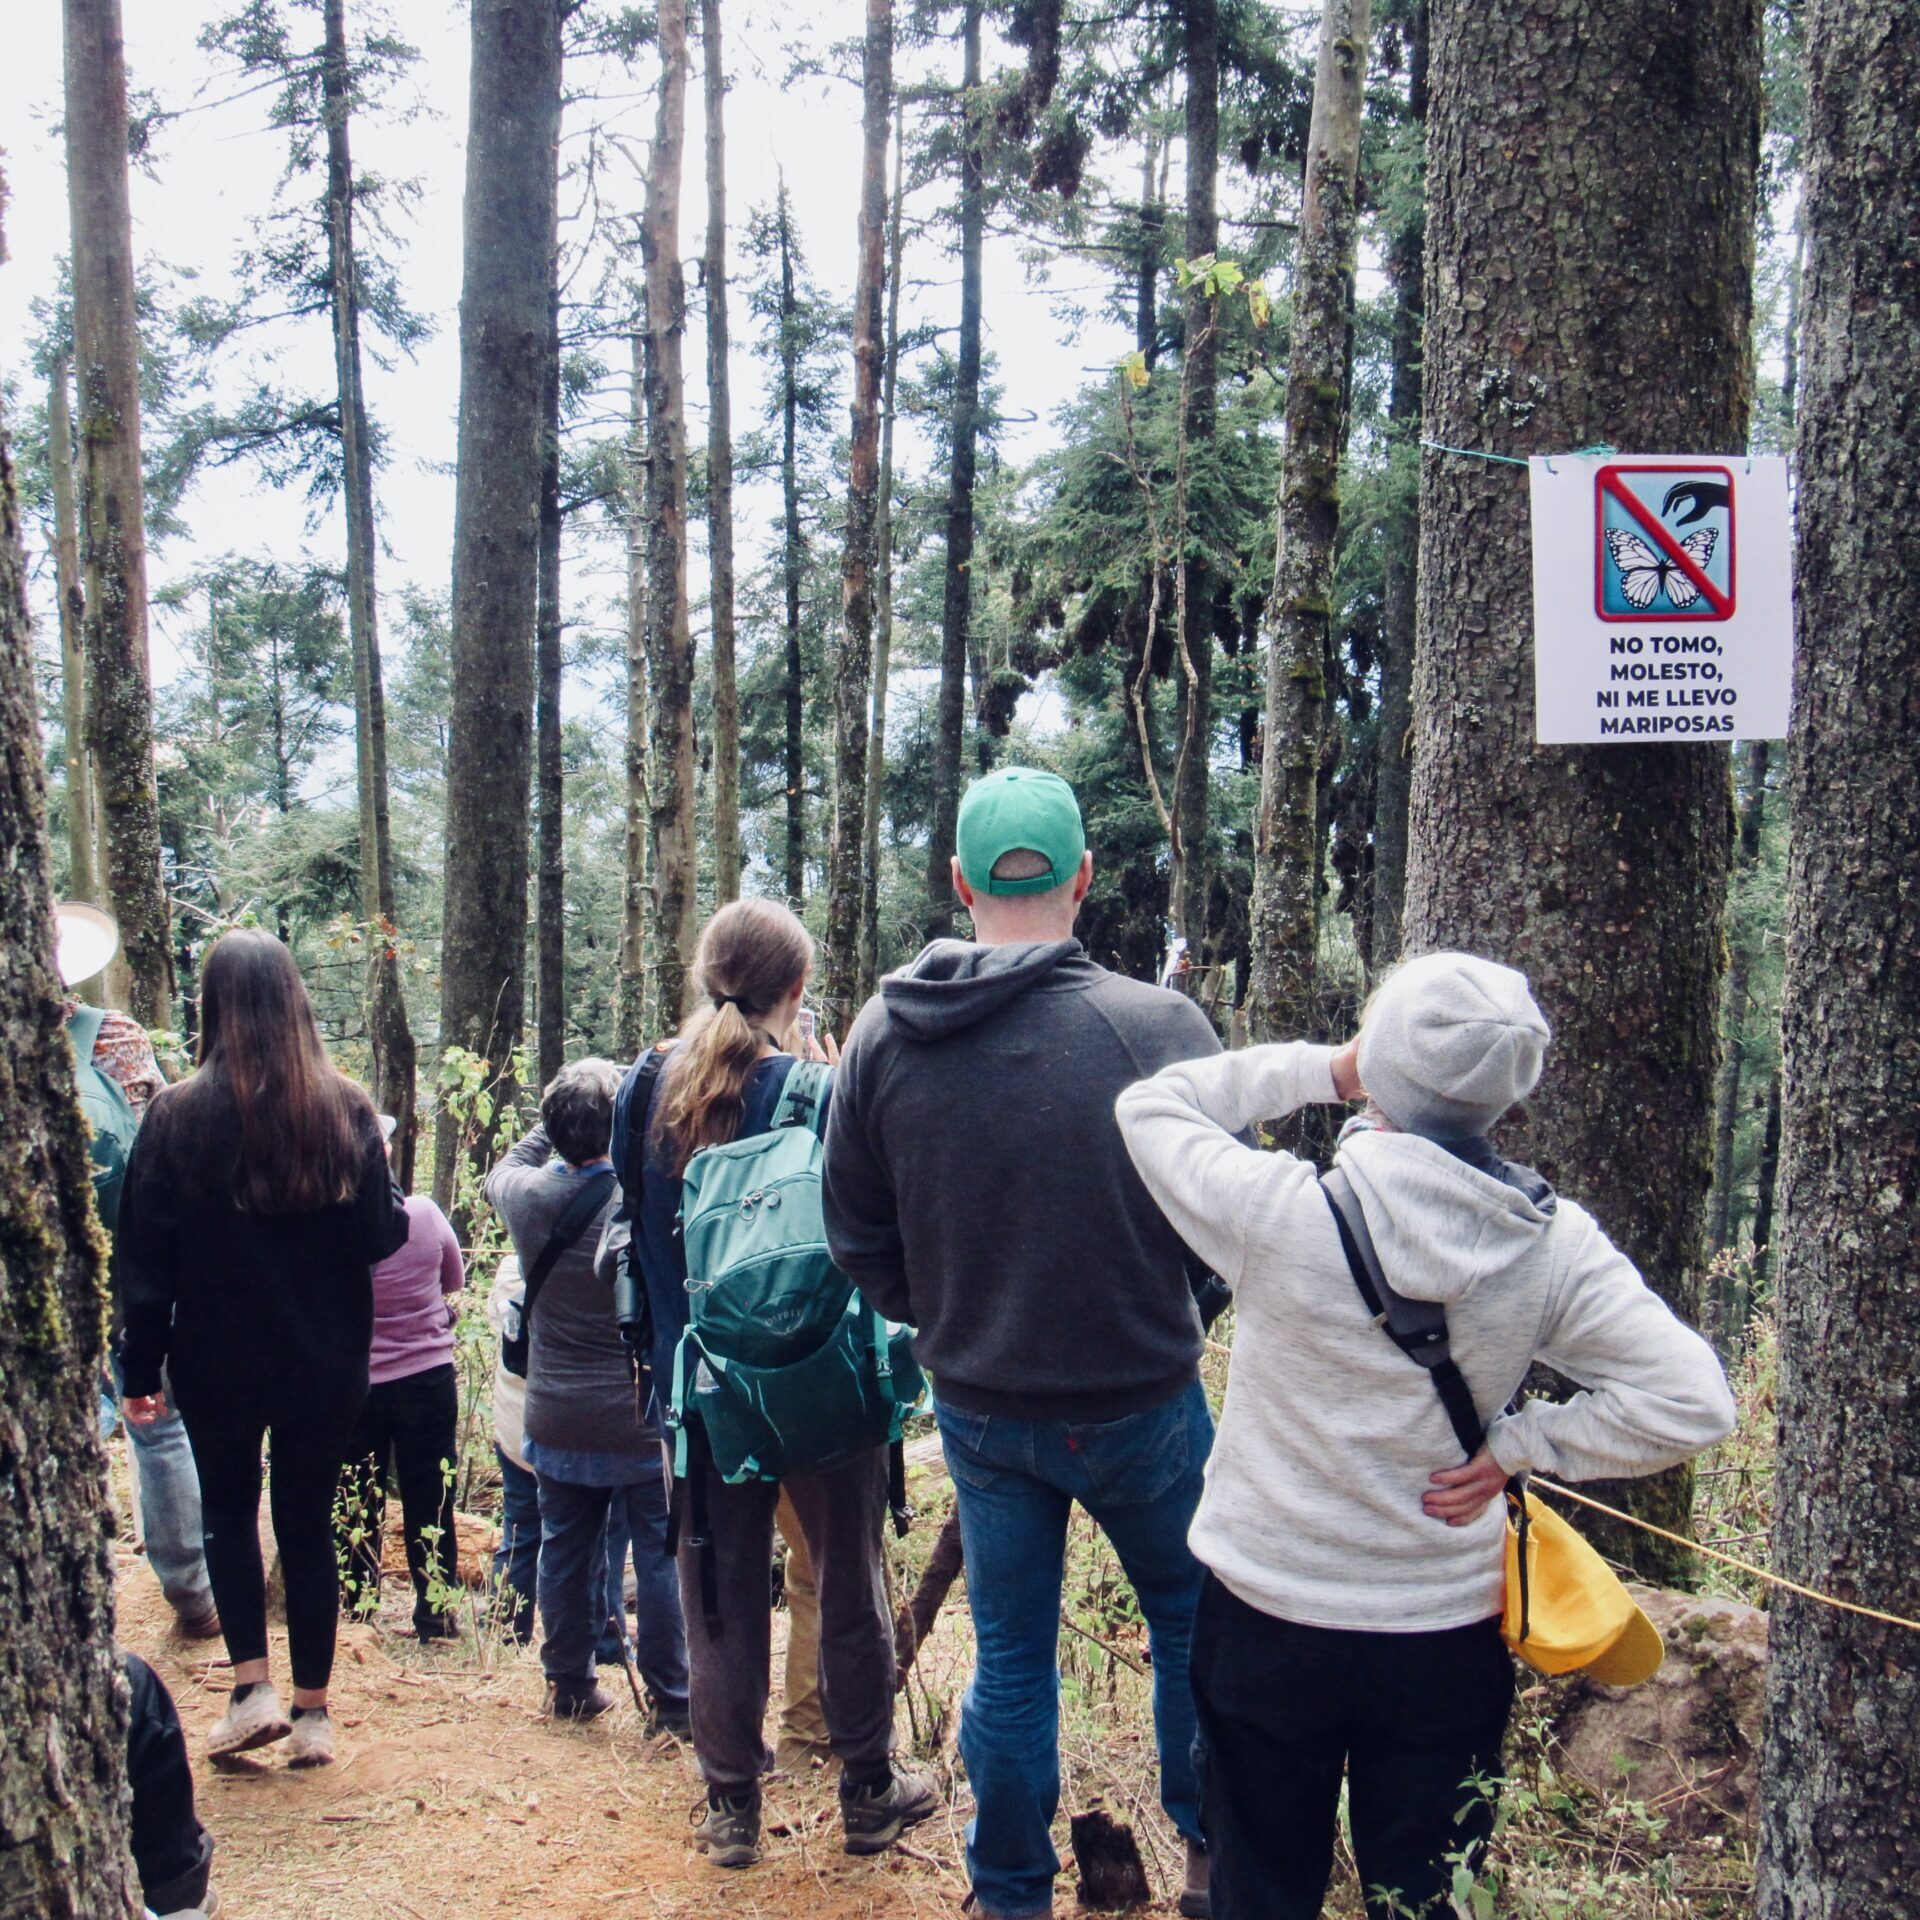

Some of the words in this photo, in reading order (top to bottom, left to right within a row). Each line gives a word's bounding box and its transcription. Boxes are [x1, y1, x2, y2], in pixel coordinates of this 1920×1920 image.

[1611, 637, 1643, 654] NO
[1650, 636, 1722, 656] TOMO,
[1611, 663, 1723, 682] MOLESTO,
[1597, 691, 1619, 707] NI
[1627, 690, 1659, 707] ME
[1667, 689, 1737, 706] LLEVO
[1601, 715, 1734, 734] MARIPOSAS
